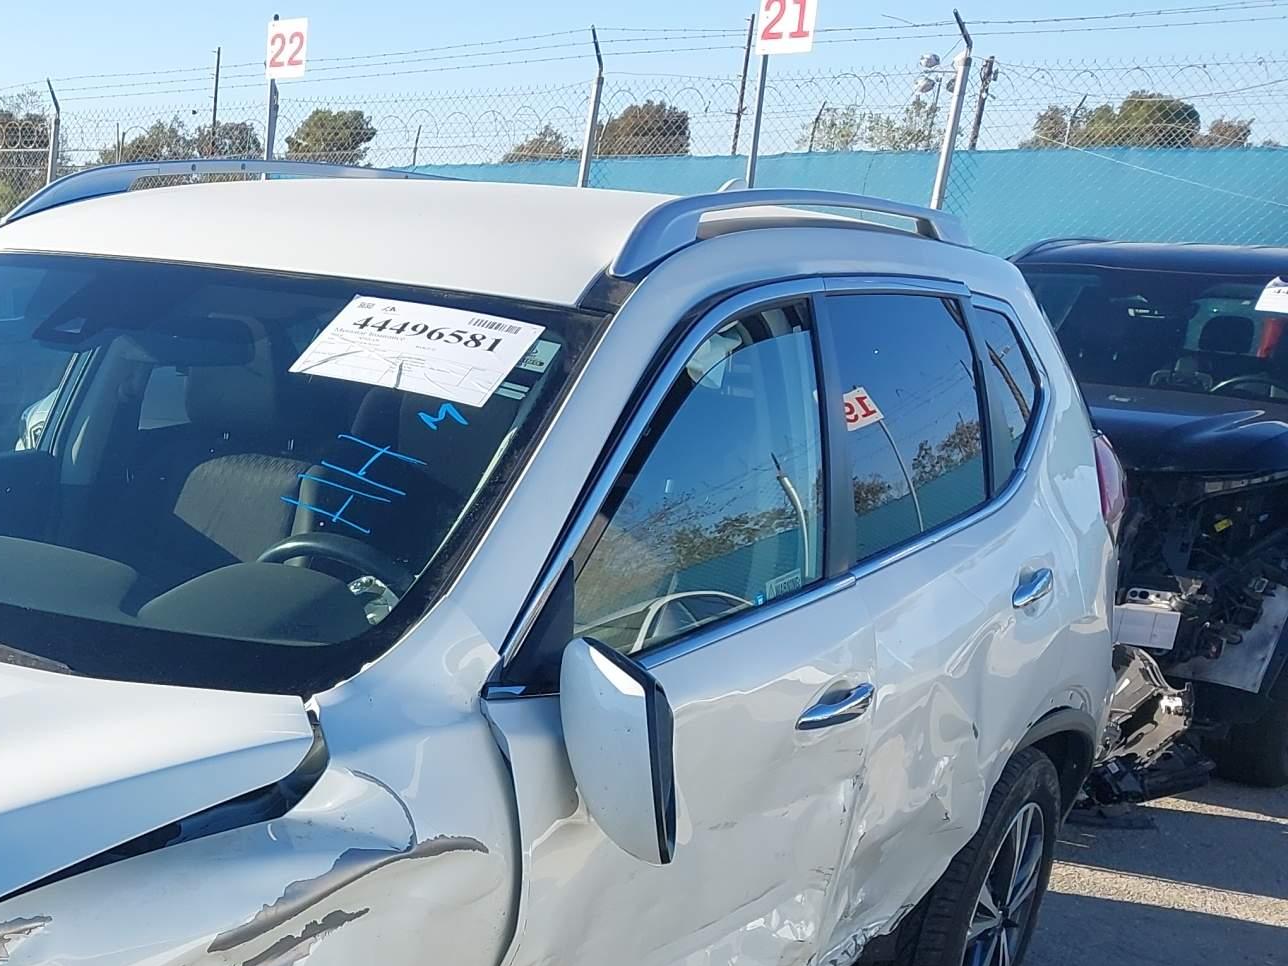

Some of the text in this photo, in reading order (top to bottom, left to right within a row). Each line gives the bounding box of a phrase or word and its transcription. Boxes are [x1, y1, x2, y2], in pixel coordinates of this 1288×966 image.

[761, 0, 809, 40] 21
[269, 31, 304, 67] 22
[352, 316, 504, 354] 44496581
